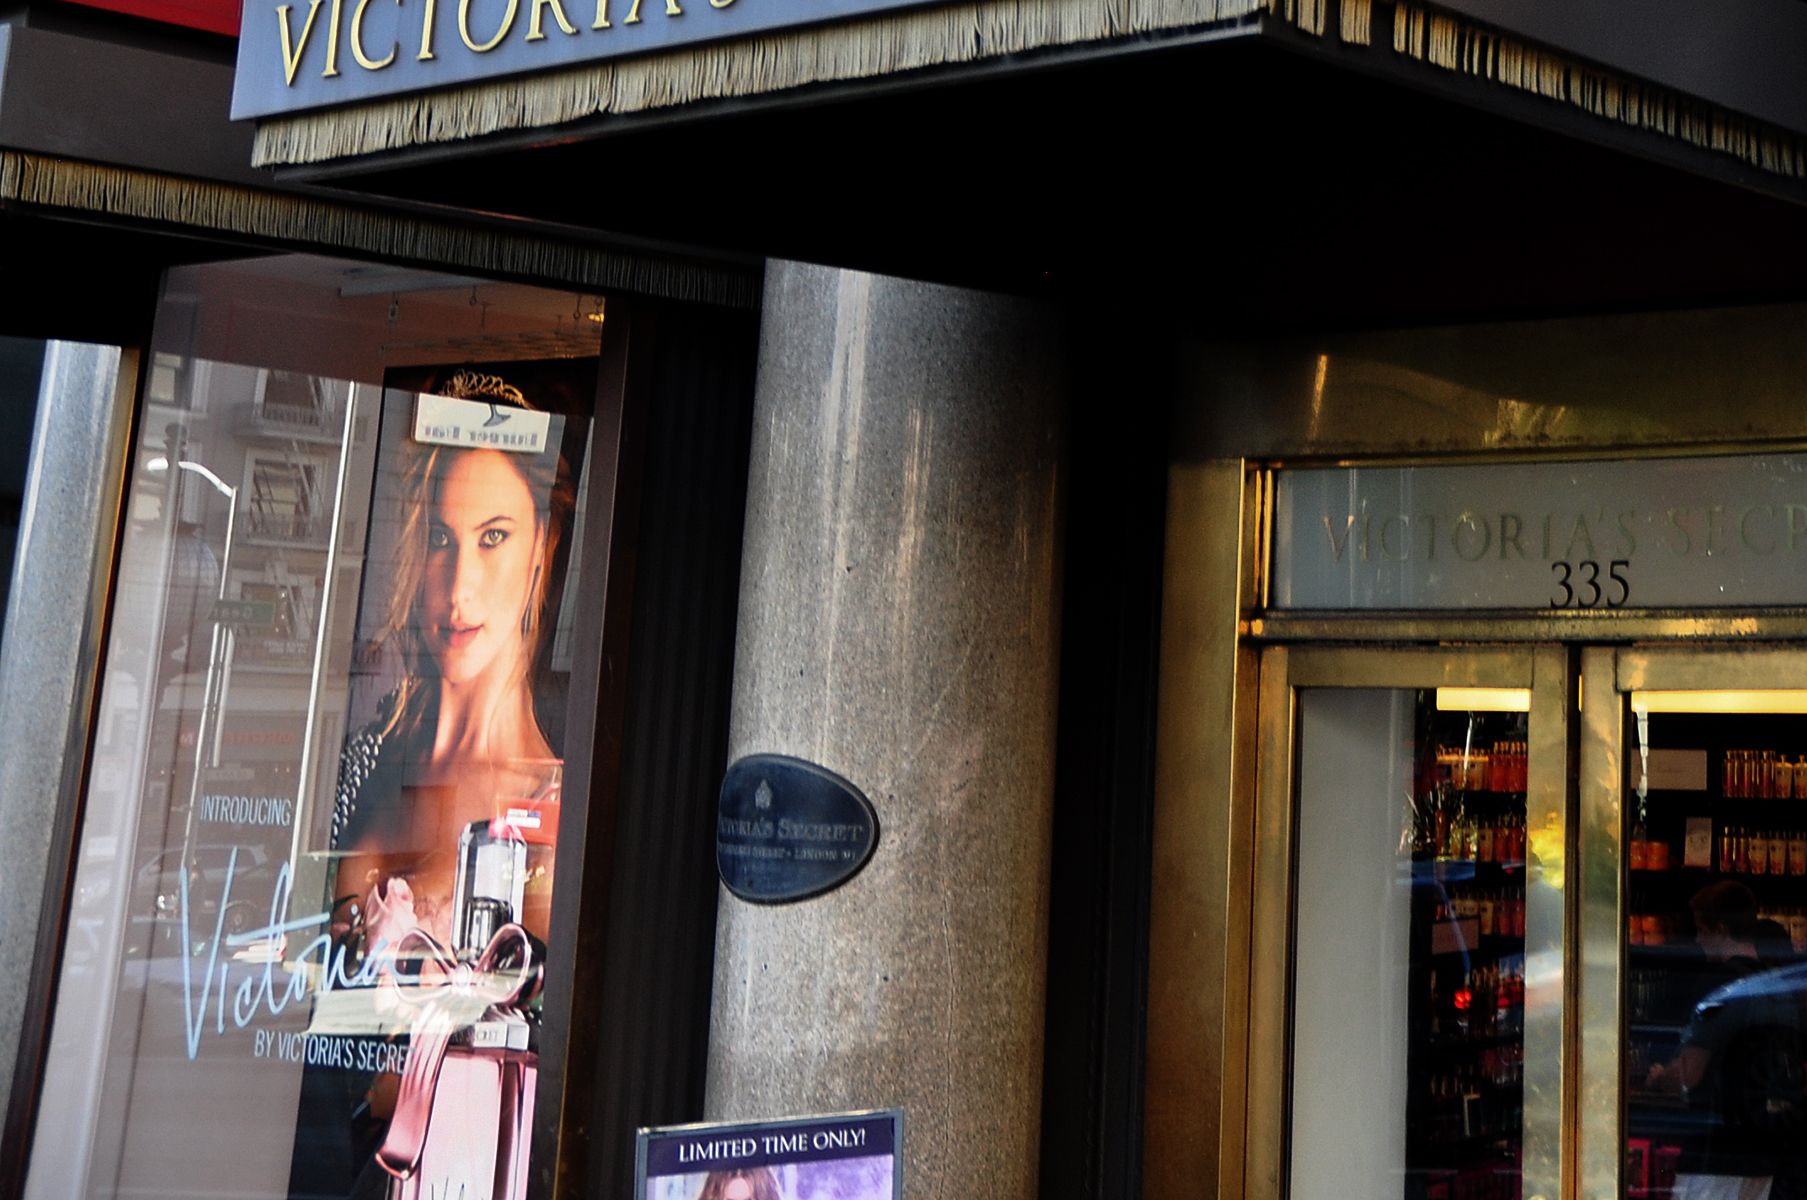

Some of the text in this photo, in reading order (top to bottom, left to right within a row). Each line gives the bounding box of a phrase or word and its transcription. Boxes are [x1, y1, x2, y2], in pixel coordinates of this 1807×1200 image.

[1324, 507, 1637, 563] VICTORIA'S
[1549, 560, 1631, 609] 335
[201, 795, 291, 827] INTRODUCING
[777, 817, 864, 841] SECRET
[254, 1029, 275, 1058] BY
[278, 1032, 354, 1068] VICTORIA'S
[679, 1127, 866, 1162] LIMITED TIME ONLY!
